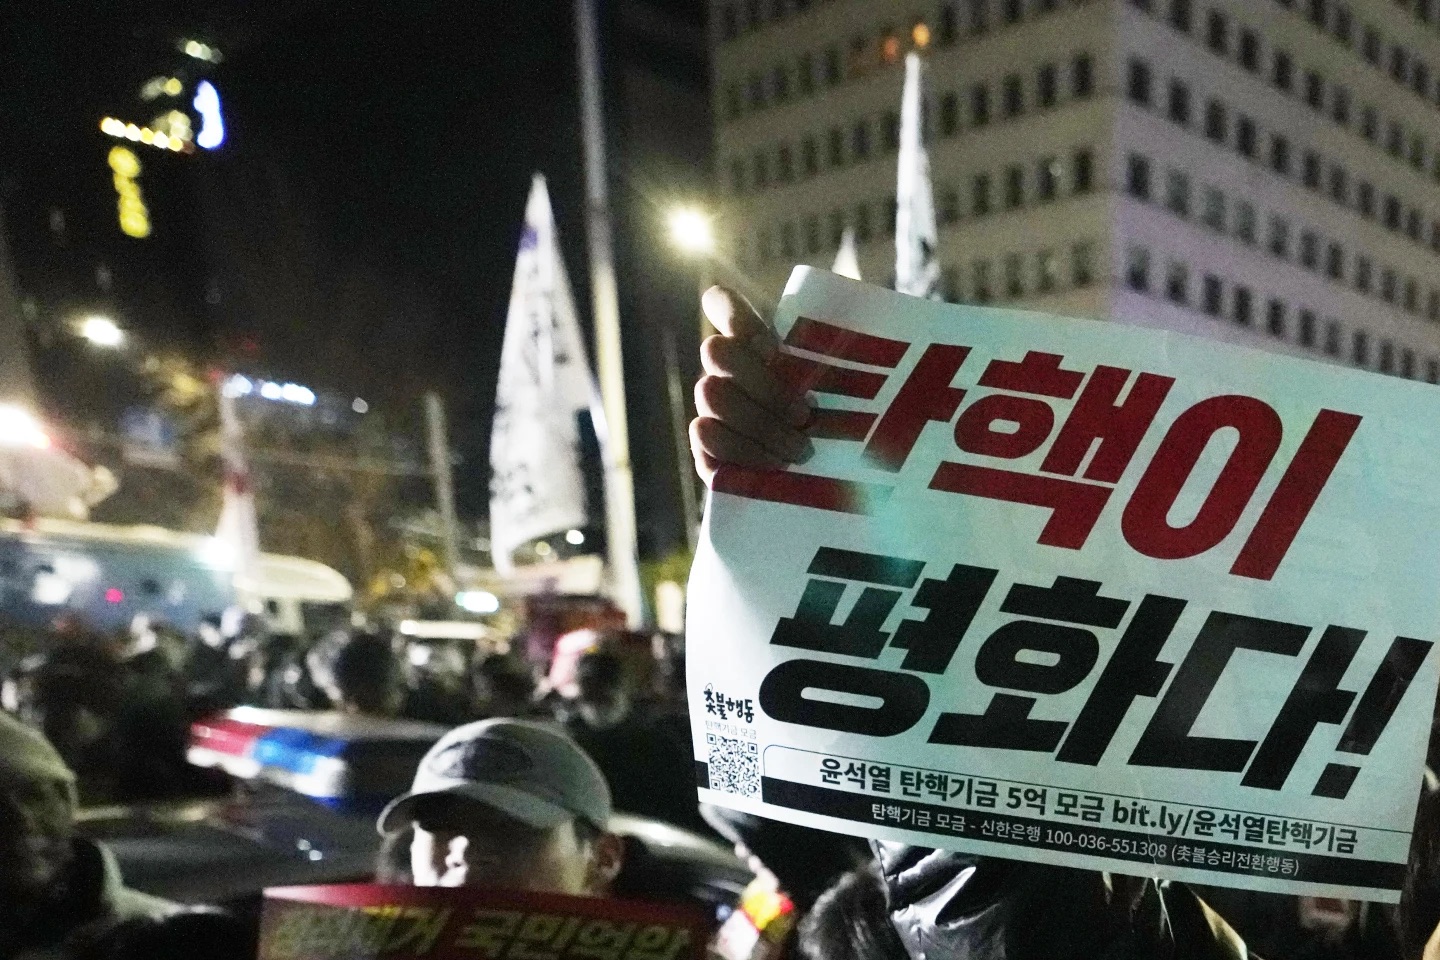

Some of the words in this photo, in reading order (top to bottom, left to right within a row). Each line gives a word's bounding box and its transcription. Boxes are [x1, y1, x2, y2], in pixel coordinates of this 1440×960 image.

[712, 316, 1362, 580] 탄핵이
[704, 683, 754, 723] 촛불행동
[758, 546, 1432, 799] 평화다!
[820, 758, 891, 793] 윤석열
[900, 771, 999, 808] 탄핵기금
[1006, 787, 1048, 816] 5억
[1054, 792, 1105, 823] 모금
[1112, 799, 1358, 854] bit.ly/윤석열탄핵기금
[871, 803, 931, 828] 탄핵기금
[935, 813, 966, 833] 모금
[980, 819, 1041, 842] 신한은행
[1046, 829, 1167, 858] 100-036-551308
[1171, 844, 1300, 876] (촛불승리전환행동)
